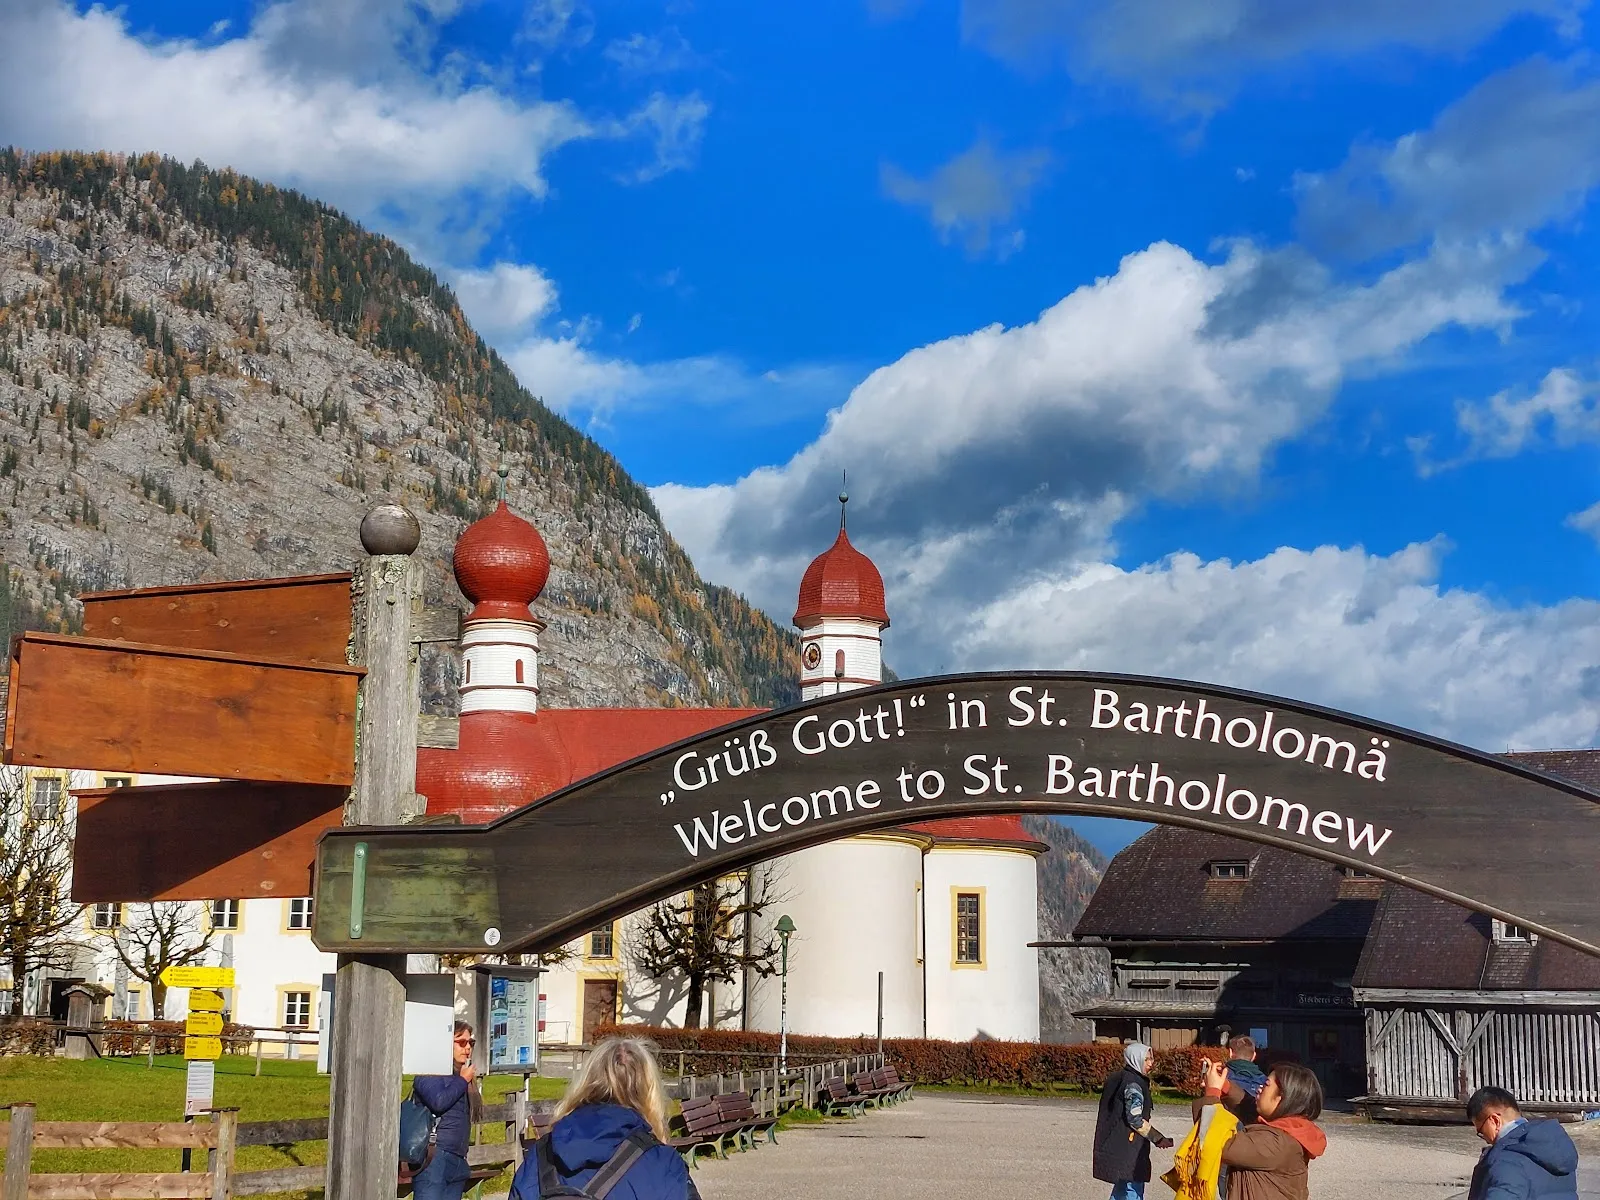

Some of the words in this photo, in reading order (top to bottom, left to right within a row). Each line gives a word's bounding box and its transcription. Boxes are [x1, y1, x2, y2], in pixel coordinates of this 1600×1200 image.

[947, 692, 988, 731] in
[1007, 686, 1068, 728] St.
[1089, 688, 1390, 783] Bartholomä
[673, 779, 882, 857] Welcome
[895, 766, 946, 802] to
[963, 754, 1024, 796] St.
[1045, 754, 1393, 857] Bartholomew
